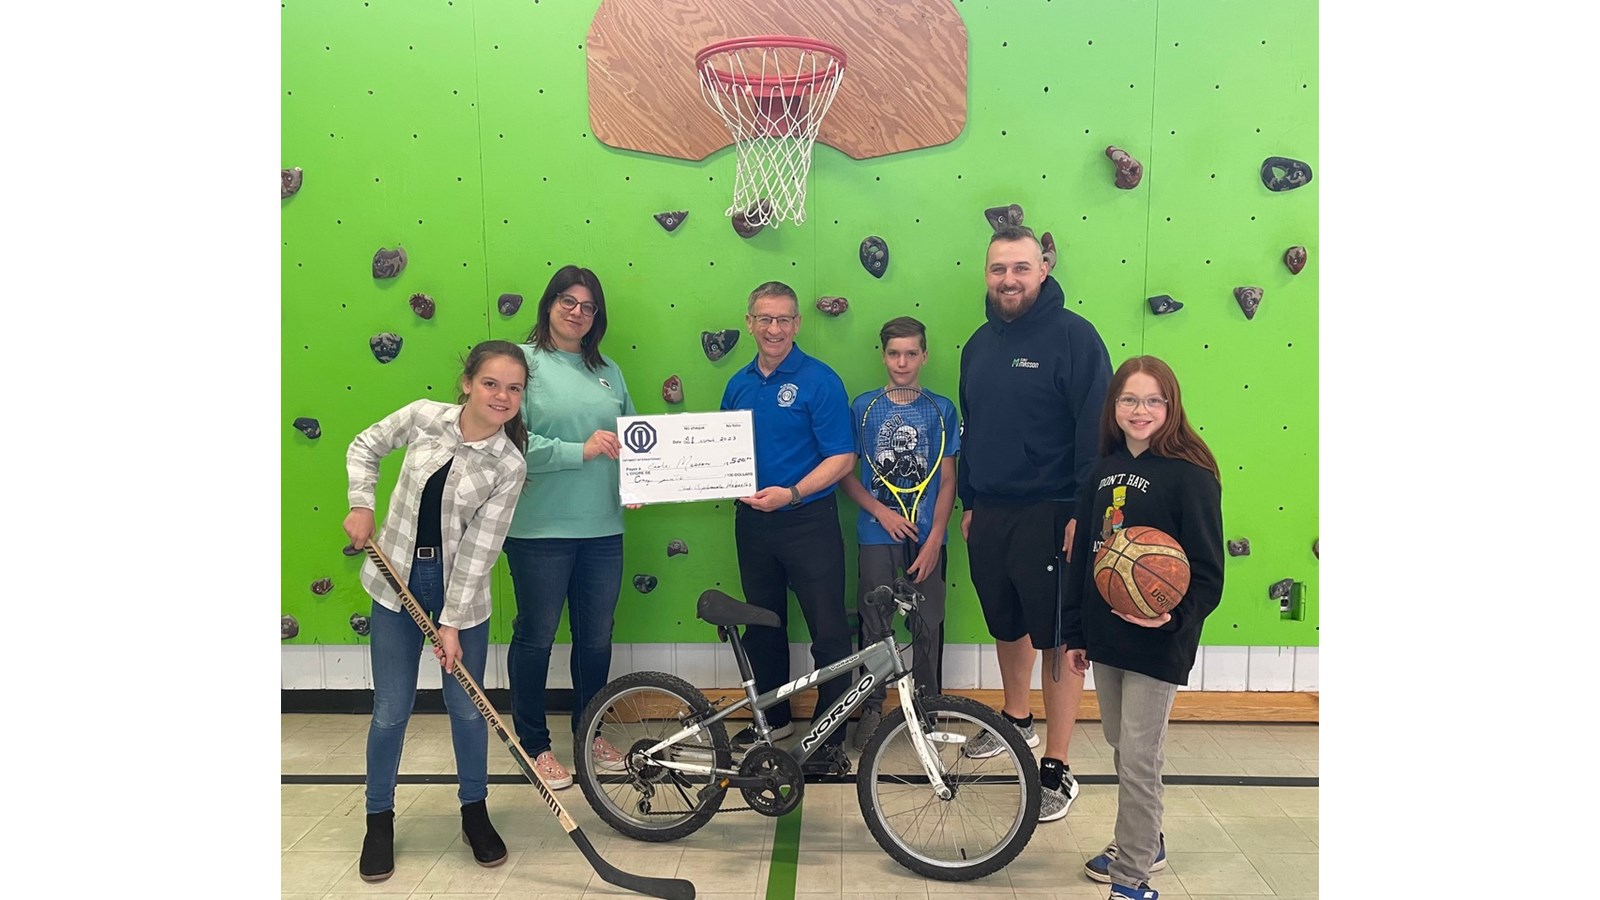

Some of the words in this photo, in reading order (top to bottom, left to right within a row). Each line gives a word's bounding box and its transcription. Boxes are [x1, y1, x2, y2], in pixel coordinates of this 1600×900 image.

[1126, 474, 1150, 493] HAVE
[397, 590, 431, 635] TOURNOI
[471, 694, 502, 733] NOVICE
[801, 674, 875, 752] NORCO
